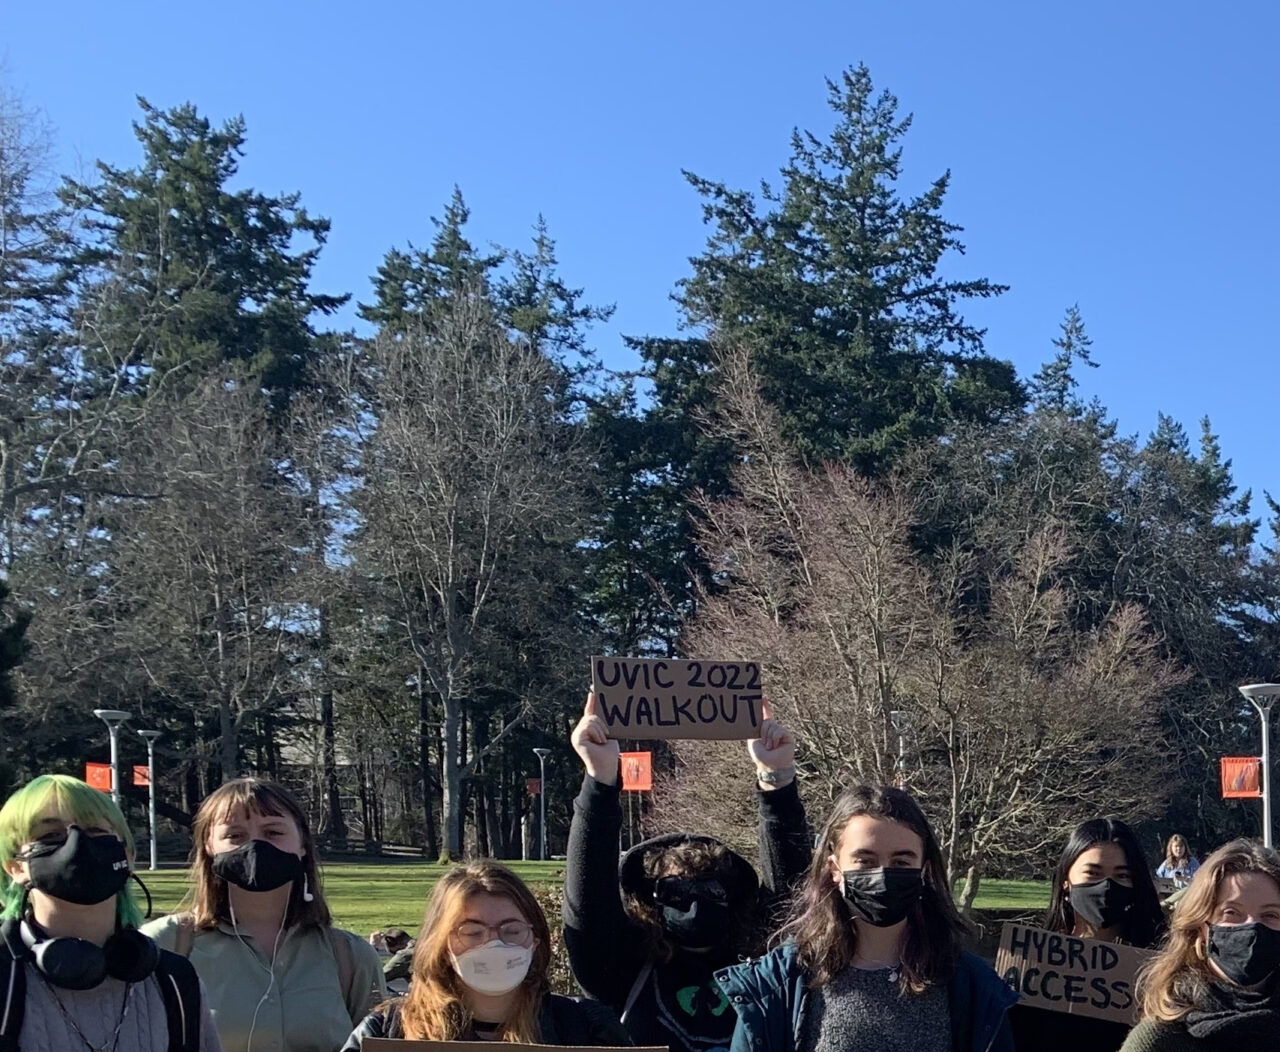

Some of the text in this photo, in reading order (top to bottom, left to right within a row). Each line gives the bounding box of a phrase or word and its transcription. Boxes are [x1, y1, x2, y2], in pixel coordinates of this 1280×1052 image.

[597, 660, 762, 690] UVIC 2022
[599, 693, 762, 727] WALKOUT
[1010, 927, 1119, 971] HYBRID
[1003, 966, 1133, 1009] ACCESS
